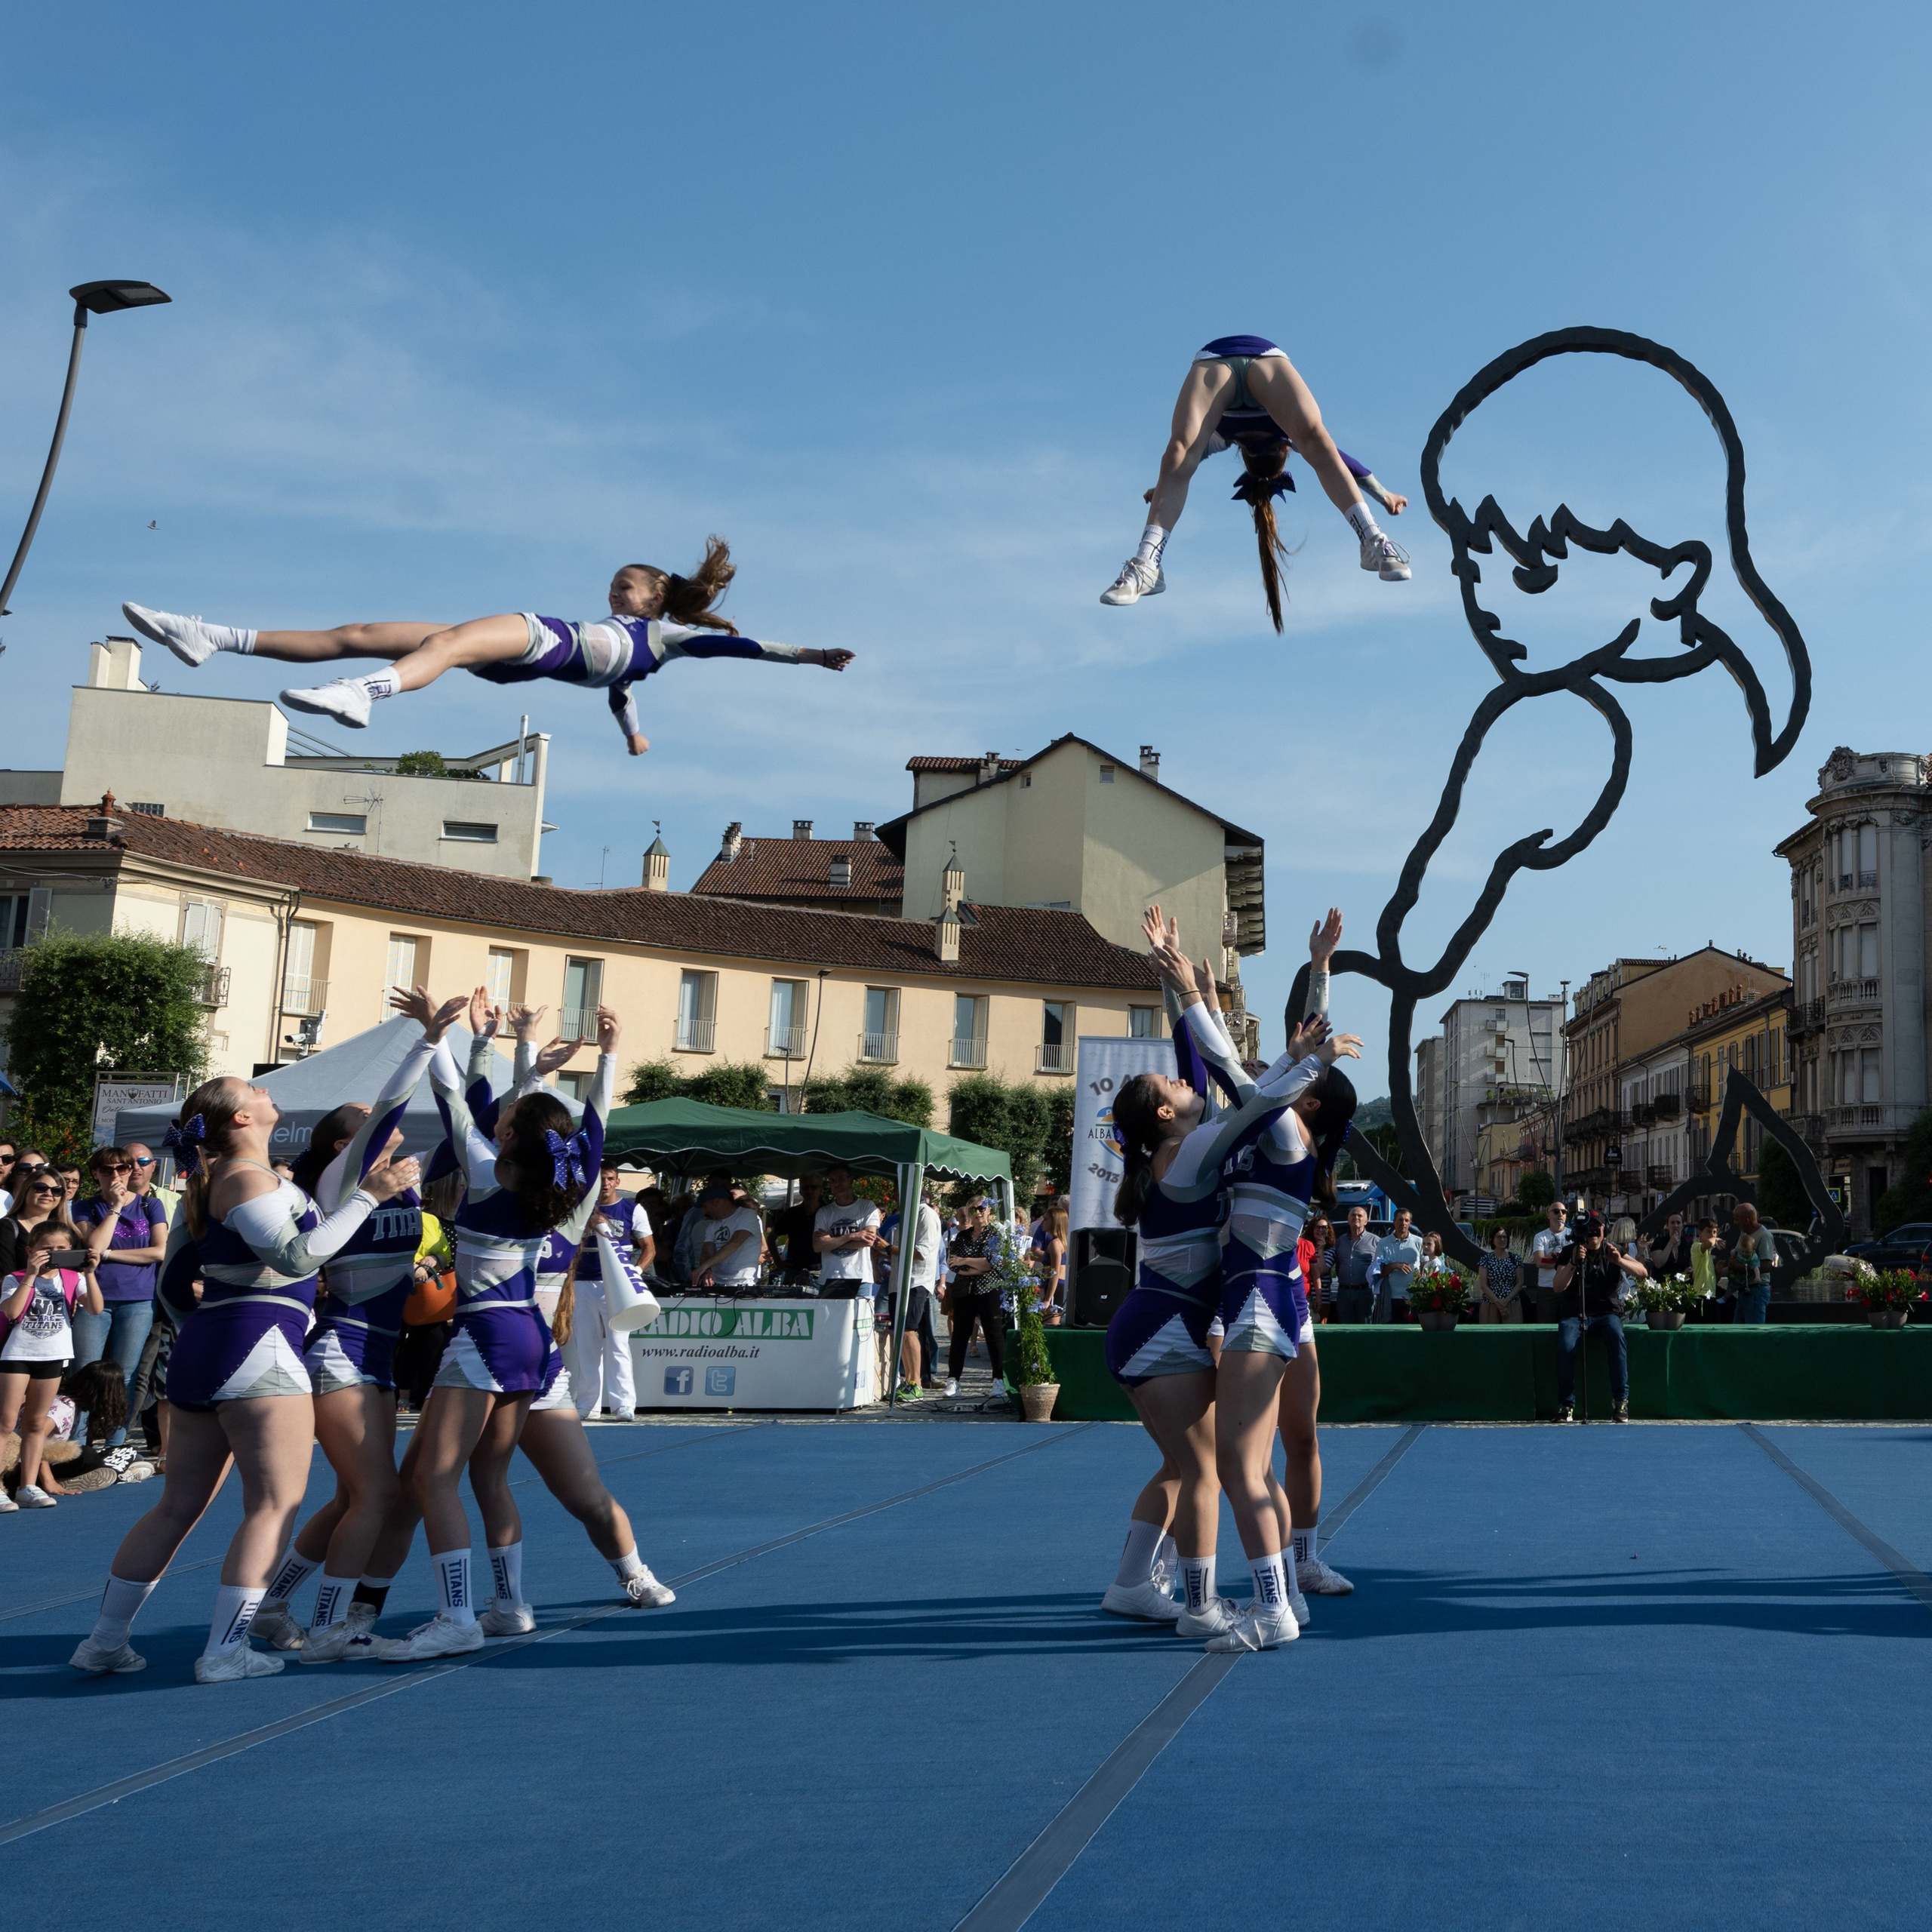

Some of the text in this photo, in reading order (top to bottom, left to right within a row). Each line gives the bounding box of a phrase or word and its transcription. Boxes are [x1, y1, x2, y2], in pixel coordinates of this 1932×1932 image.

[1089, 1078, 1114, 1096] 10
[1088, 1128, 1112, 1139] ALBA
[1088, 1163, 1119, 1183] 2013
[370, 1207, 421, 1241] TITA
[733, 1312, 810, 1337] ALBA
[642, 1346, 760, 1358] www.radioalba.it
[269, 1563, 303, 1599] TITANS
[448, 1559, 463, 1607] TITANS
[491, 1557, 508, 1600] TITANS
[1189, 1568, 1201, 1608] TITANS
[1260, 1566, 1278, 1604] TITANS
[228, 1600, 261, 1644] TITANS
[315, 1586, 335, 1627] TITANS
